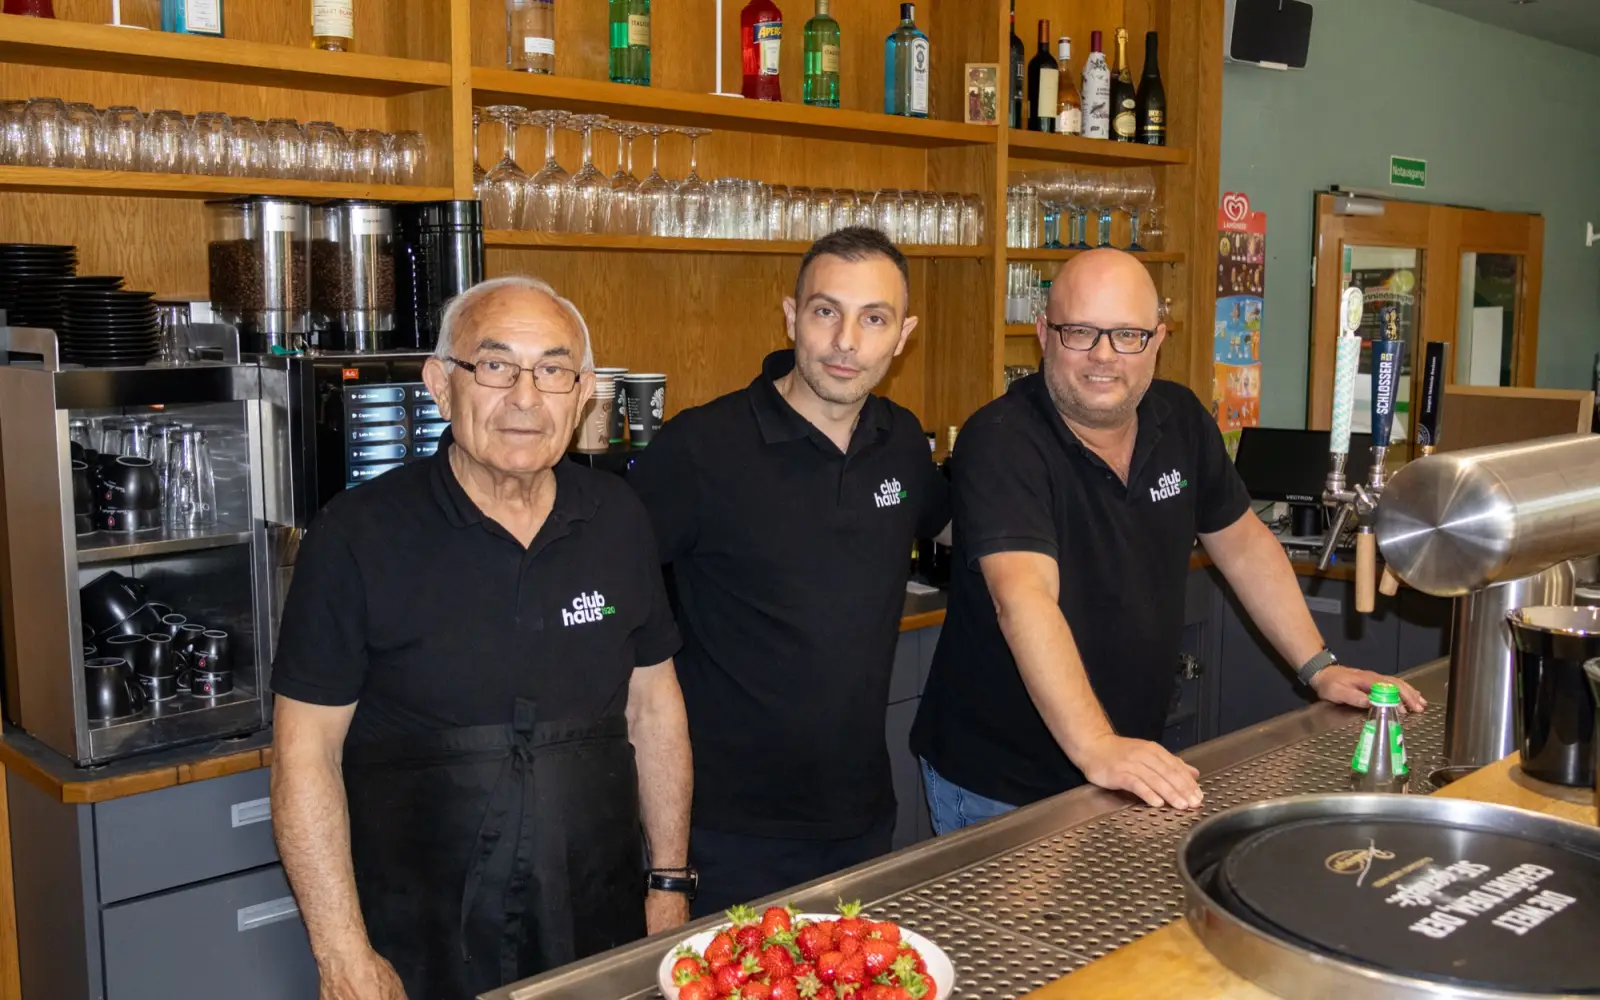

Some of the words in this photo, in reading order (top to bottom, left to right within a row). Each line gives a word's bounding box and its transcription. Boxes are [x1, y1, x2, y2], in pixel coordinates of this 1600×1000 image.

[1392, 163, 1425, 182] Notausgang
[1380, 352, 1394, 361] ALT
[880, 477, 901, 495] club
[1158, 468, 1181, 488] club
[873, 491, 901, 508] haus
[1149, 482, 1181, 502] haus
[572, 590, 605, 610] club
[561, 607, 603, 626] haus
[1479, 863, 1554, 899] GEHÖRT
[1434, 890, 1504, 917] DEM,
[1525, 889, 1577, 912] DIE
[1408, 910, 1468, 938] DER
[1491, 903, 1555, 936] WELT
